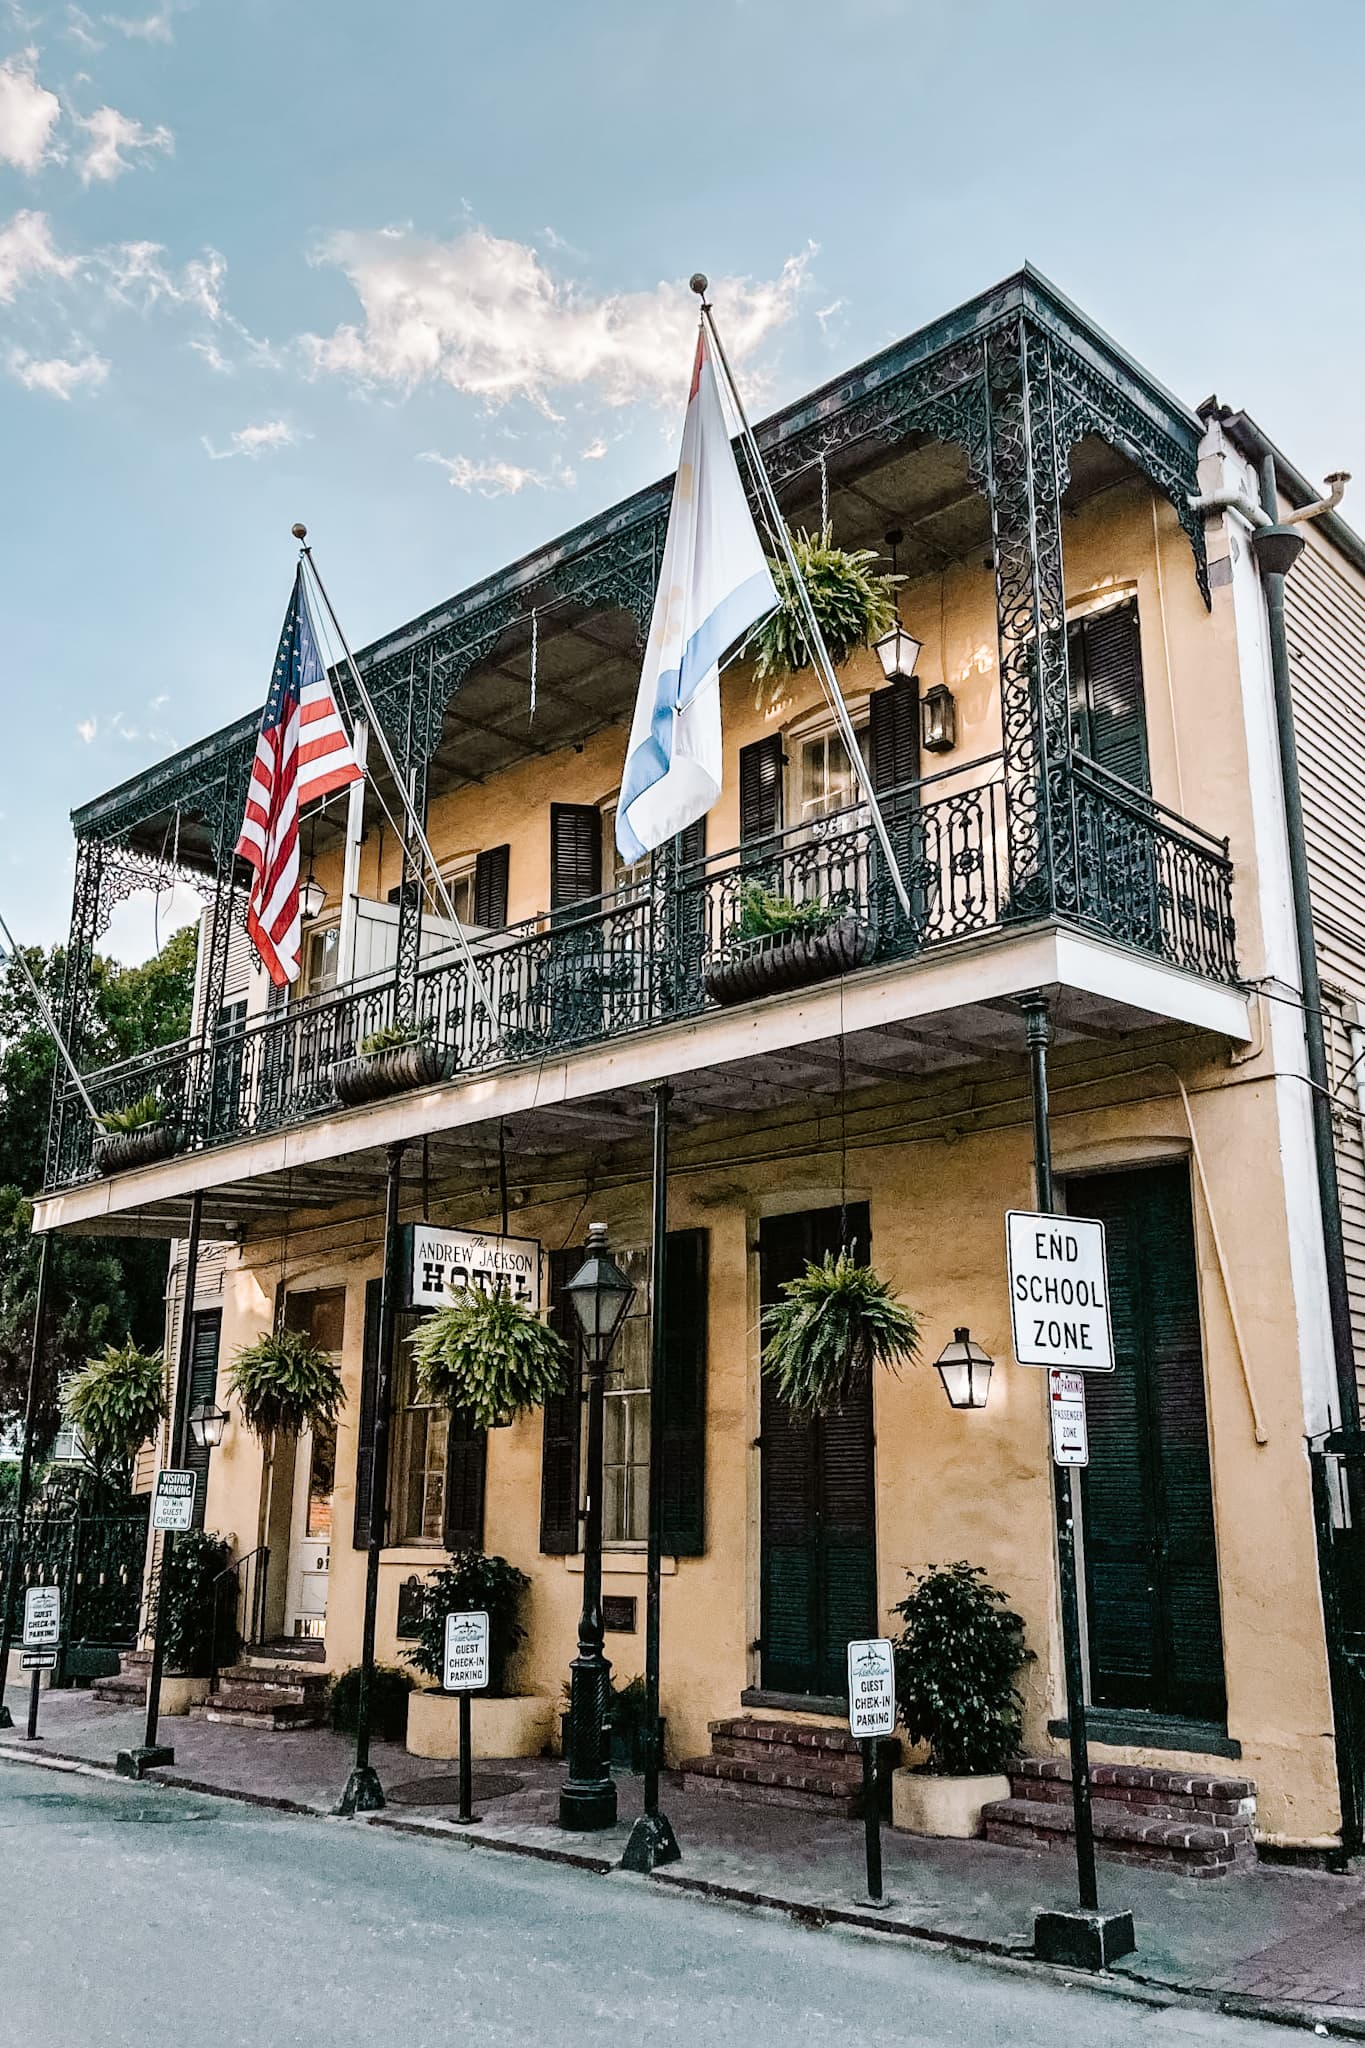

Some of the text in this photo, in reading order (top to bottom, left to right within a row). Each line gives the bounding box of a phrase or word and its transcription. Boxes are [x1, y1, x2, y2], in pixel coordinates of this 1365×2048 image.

[470, 1237, 488, 1249] The
[1036, 1233, 1078, 1262] END
[419, 1241, 533, 1273] ANDREW JACKSON
[1016, 1274, 1104, 1308] SCHOOL
[1033, 1320, 1093, 1350] ZONE
[1061, 1379, 1083, 1394] PARKING
[1062, 1427, 1077, 1438] ZONE
[162, 1473, 190, 1484] VISITOR
[158, 1484, 191, 1496] PARKING
[162, 1508, 182, 1516] GUEST
[156, 1516, 177, 1525] CHECK
[33, 1610, 52, 1618] GUEST
[28, 1629, 55, 1638] PARKING
[455, 1644, 479, 1655] GUEST
[449, 1656, 484, 1668] CHECK-IN
[450, 1670, 483, 1681] PARKING
[860, 1679, 884, 1693] GUEST
[855, 1695, 891, 1710] CHECK-IN
[856, 1712, 889, 1727] PARKING
